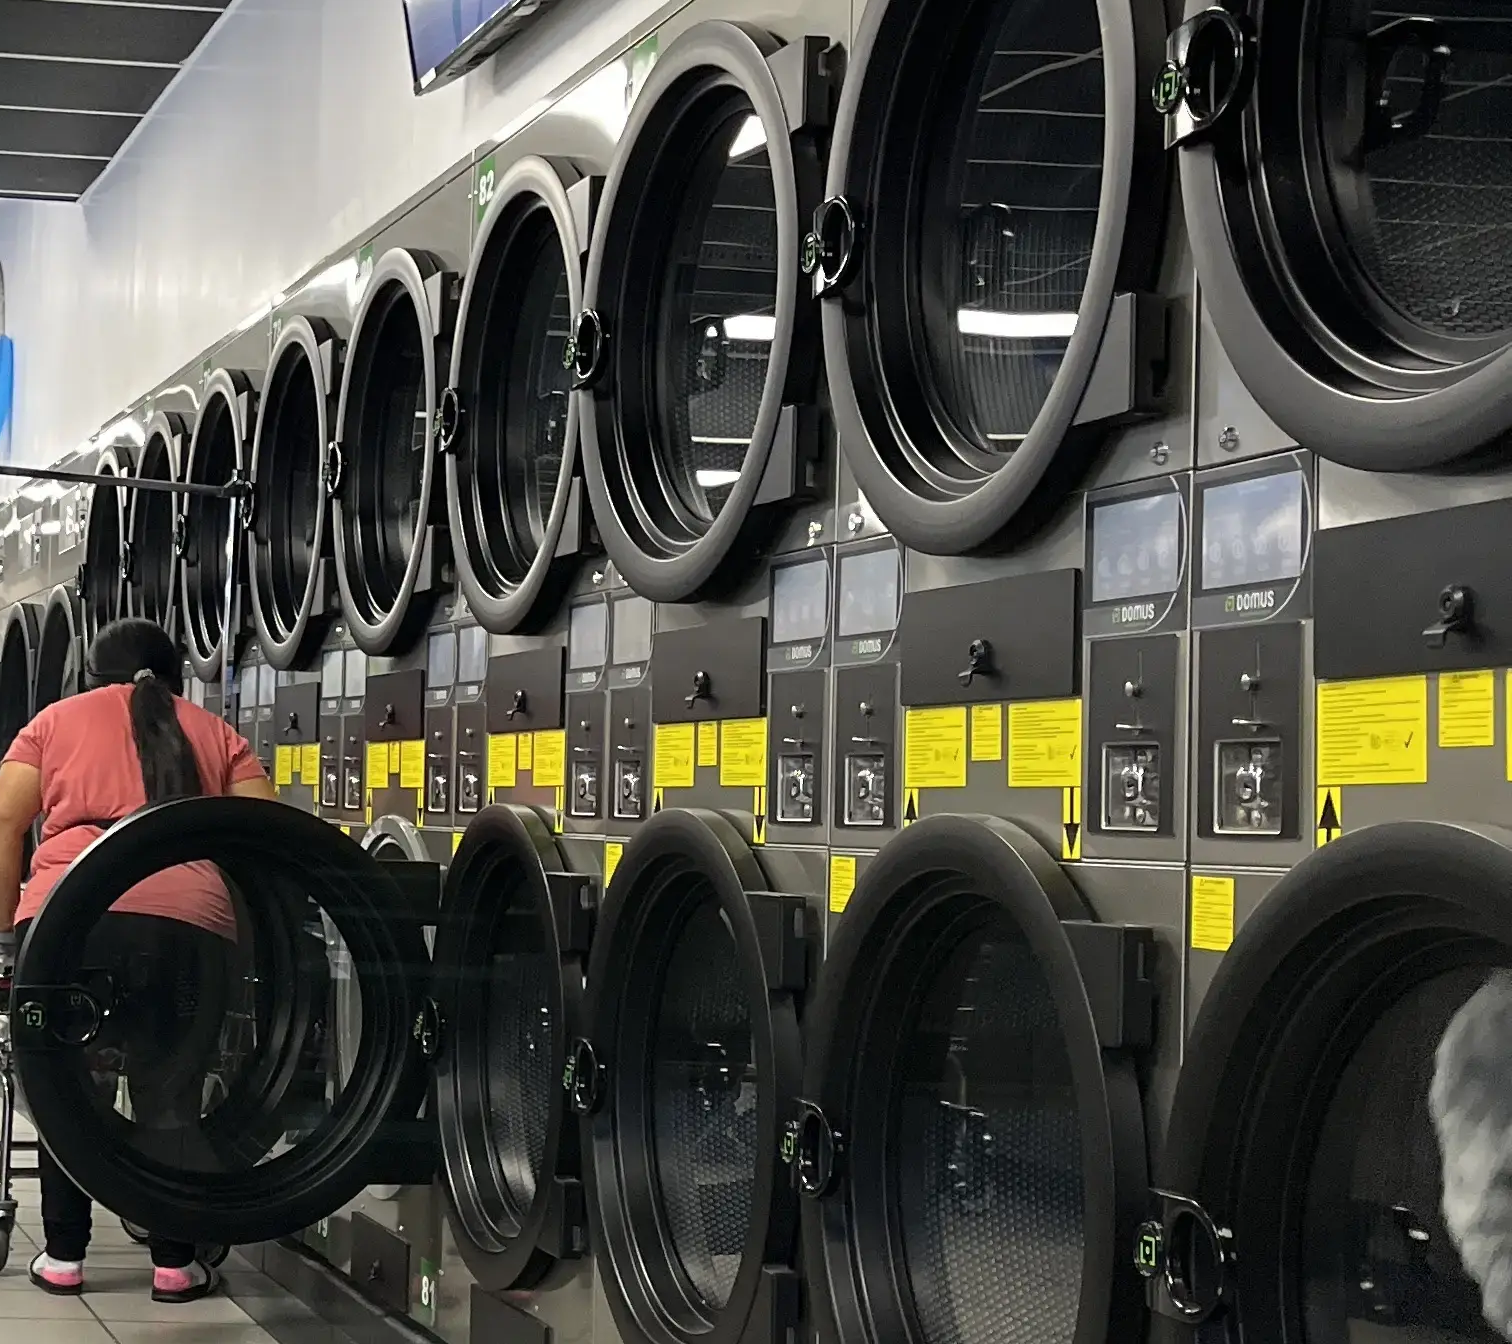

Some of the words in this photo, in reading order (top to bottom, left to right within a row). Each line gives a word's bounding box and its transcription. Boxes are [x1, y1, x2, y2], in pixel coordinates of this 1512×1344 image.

[479, 169, 494, 205] 82
[1121, 603, 1155, 622] DOMUS
[1236, 589, 1275, 611] DOMUS
[421, 1275, 435, 1309] 81
